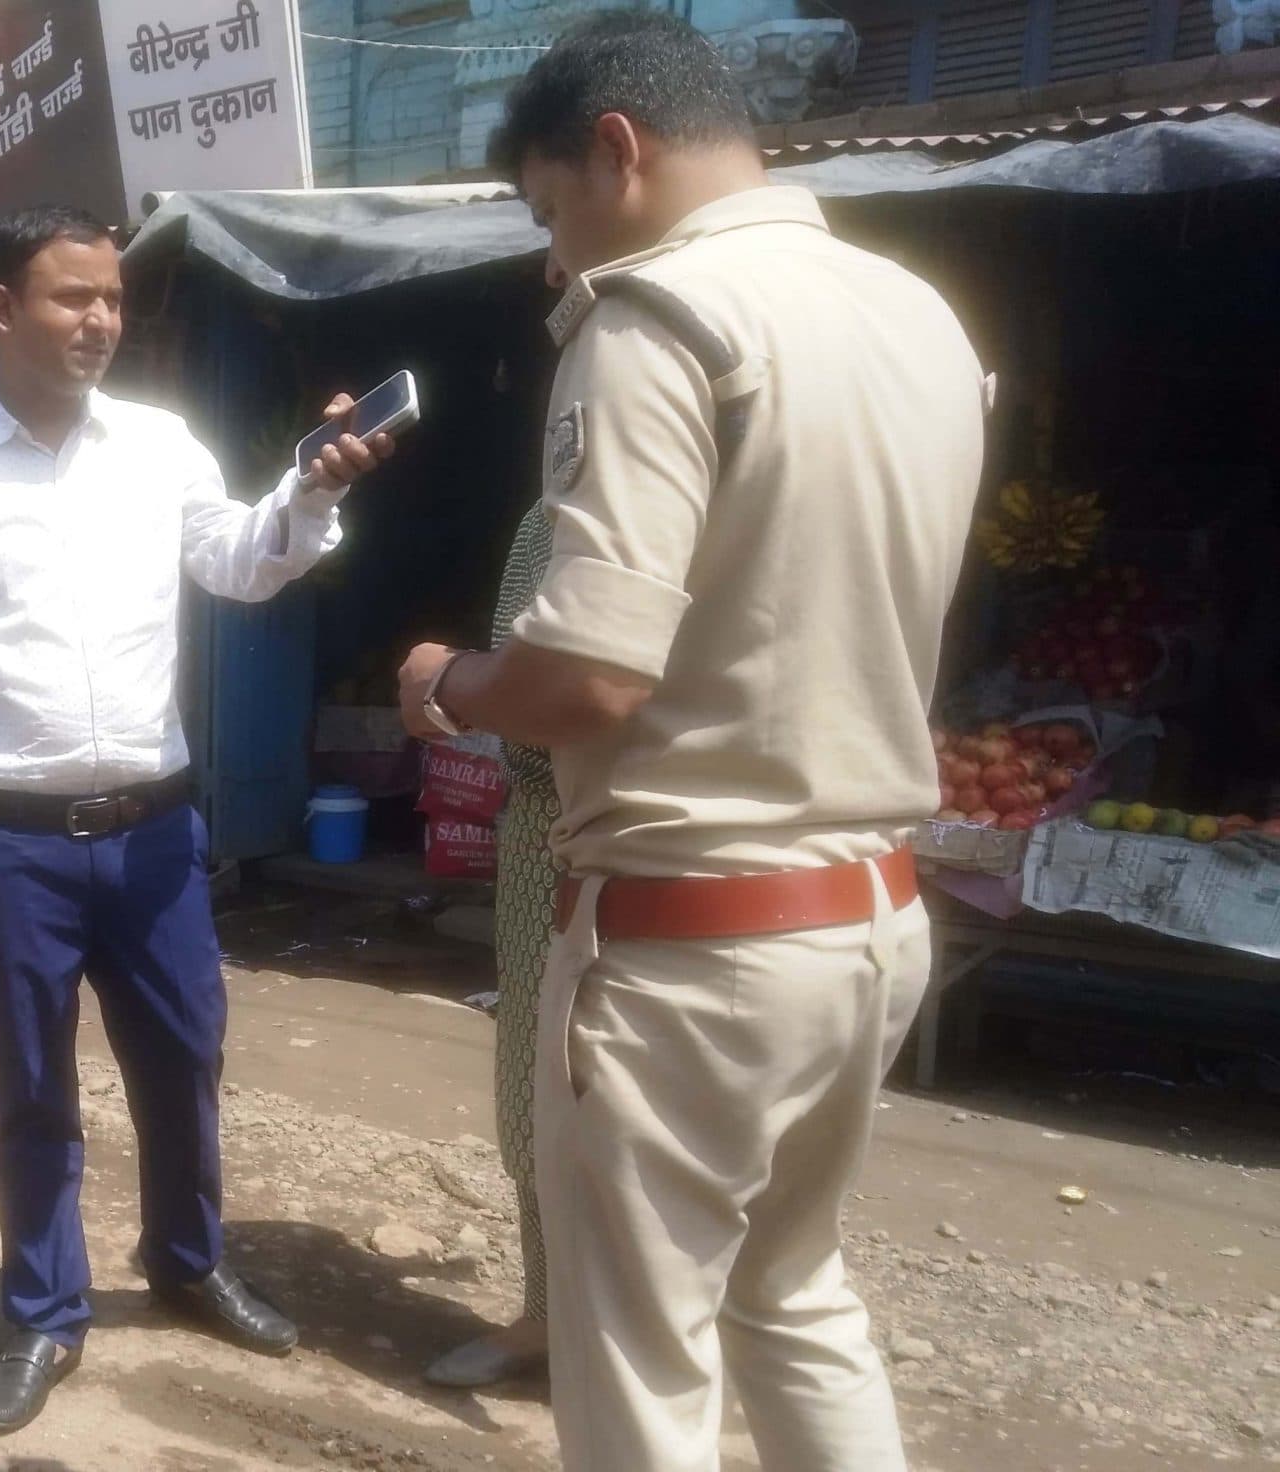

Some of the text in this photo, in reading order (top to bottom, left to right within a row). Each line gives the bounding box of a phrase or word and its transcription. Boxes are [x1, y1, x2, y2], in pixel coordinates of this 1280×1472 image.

[216, 0, 260, 52] जी
[128, 77, 278, 149] पान दुकान
[429, 758, 499, 791] SAMRAT
